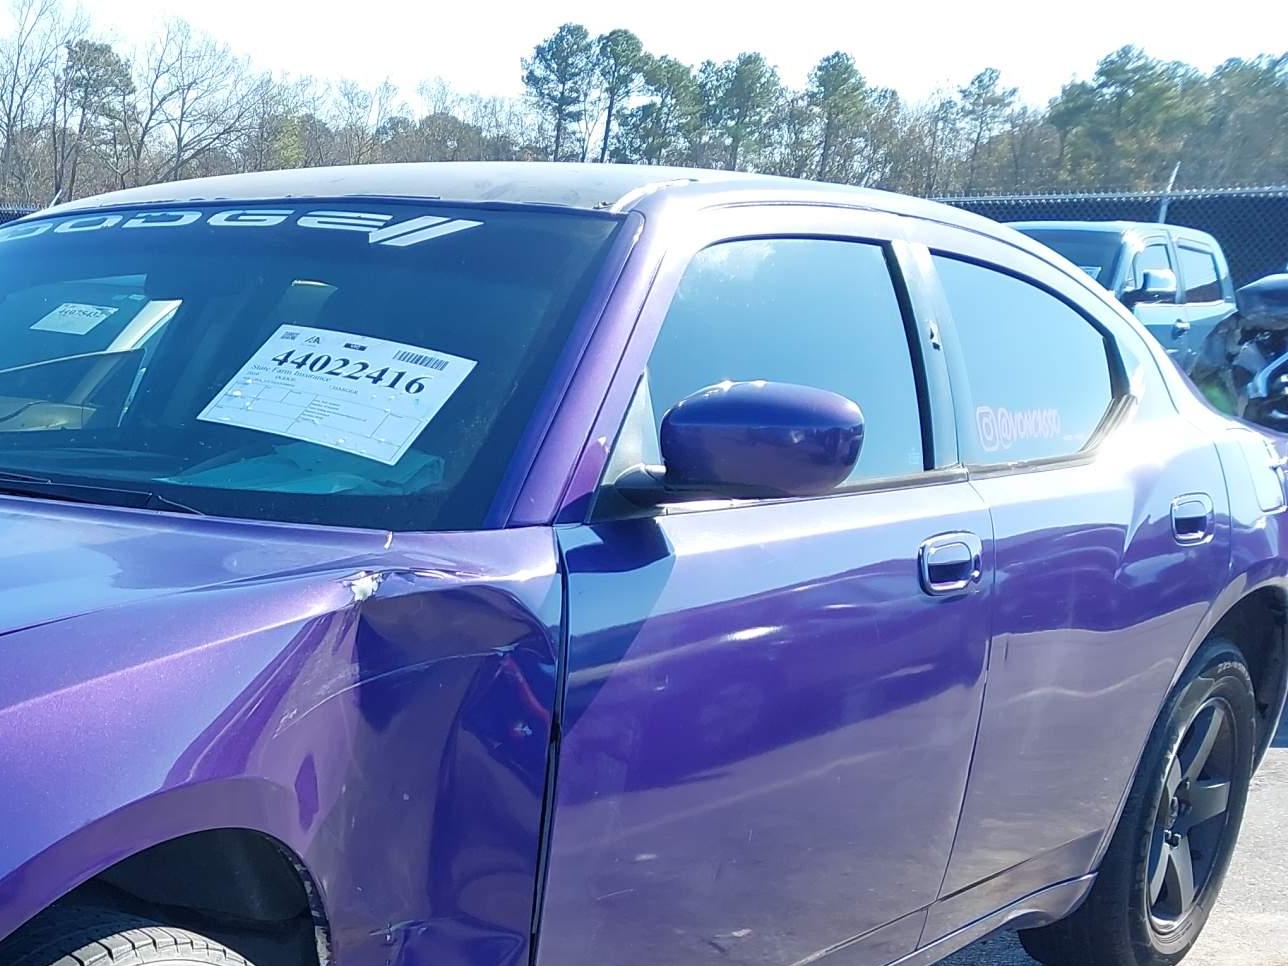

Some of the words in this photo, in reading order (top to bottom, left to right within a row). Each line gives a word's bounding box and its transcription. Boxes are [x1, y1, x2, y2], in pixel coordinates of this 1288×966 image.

[271, 349, 433, 395] 44022416
[271, 366, 292, 377] Farm
[294, 370, 332, 383] Insurance
